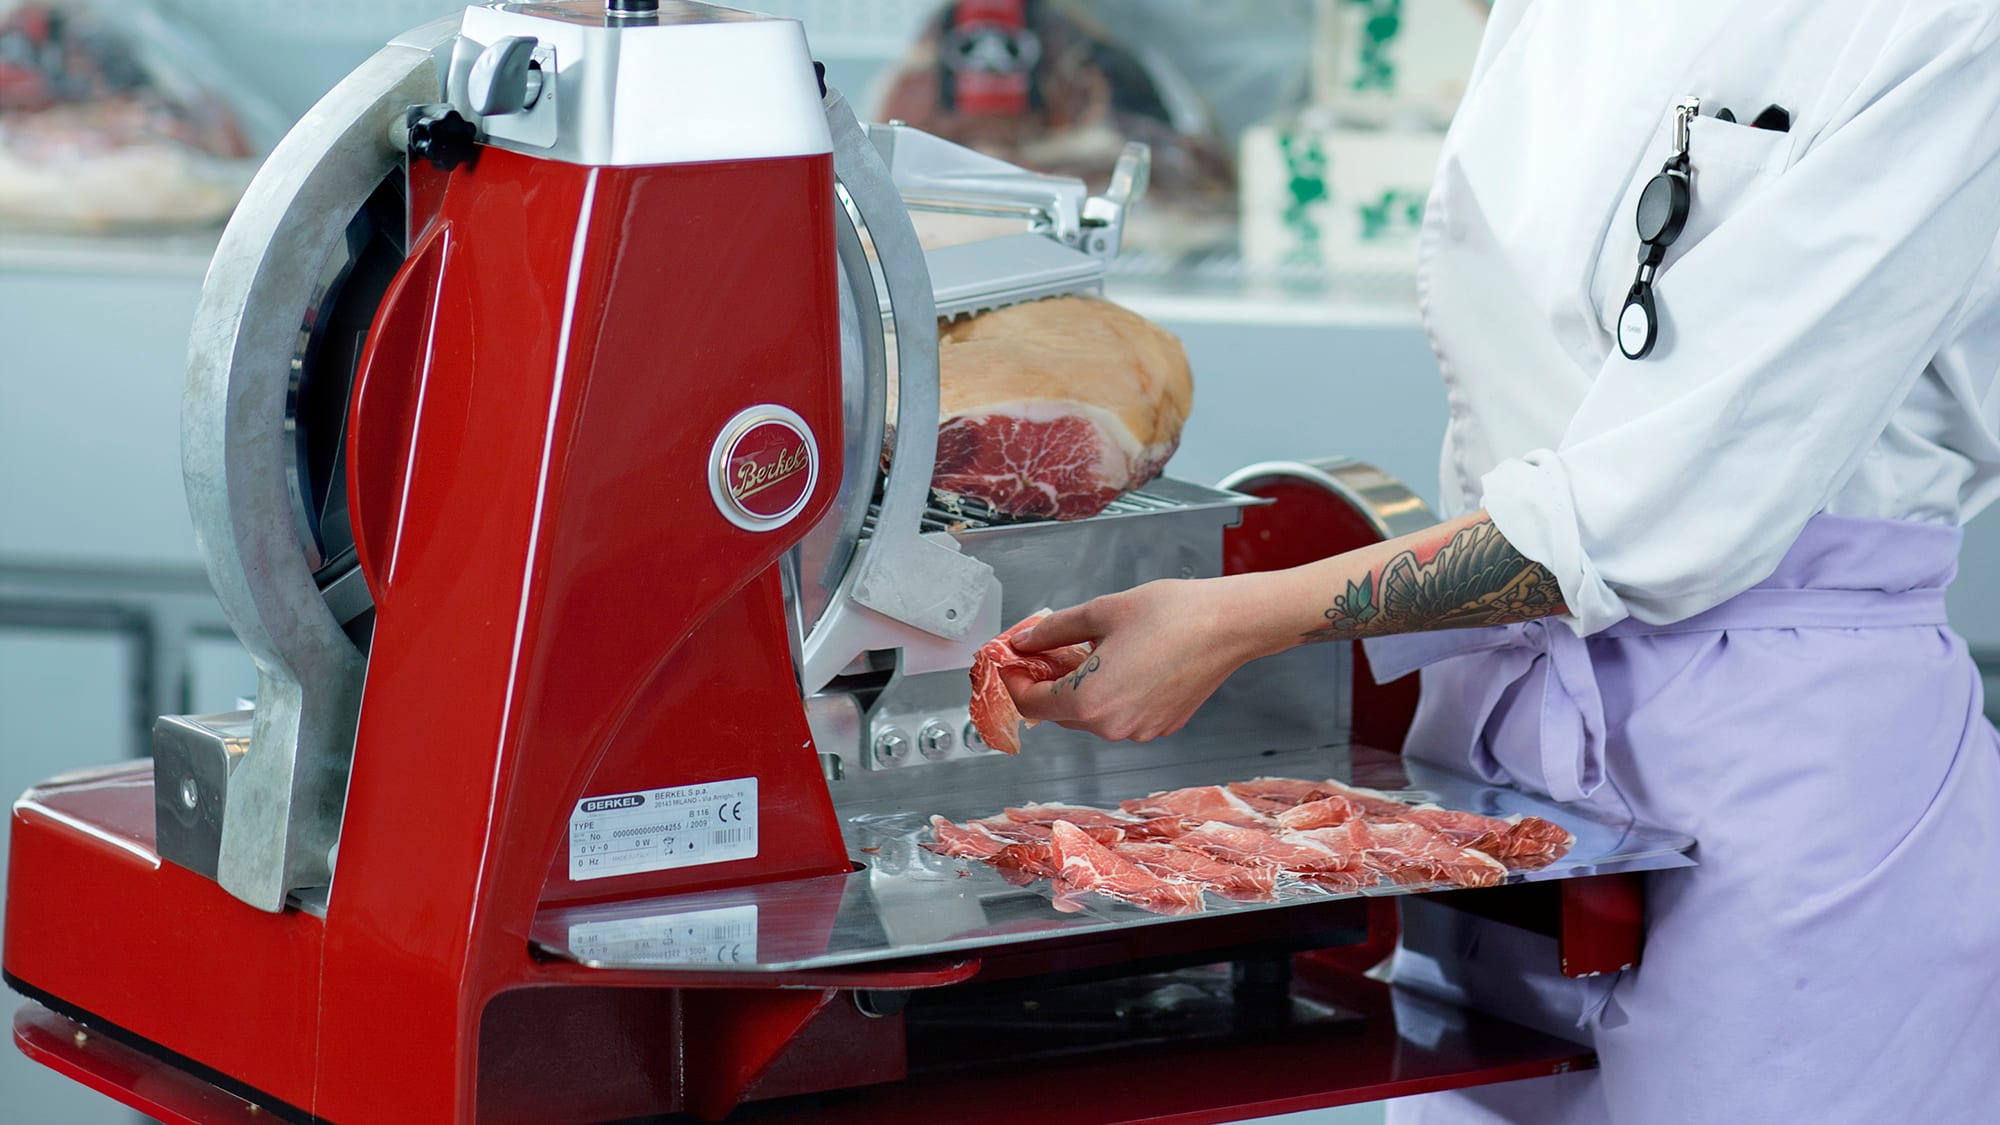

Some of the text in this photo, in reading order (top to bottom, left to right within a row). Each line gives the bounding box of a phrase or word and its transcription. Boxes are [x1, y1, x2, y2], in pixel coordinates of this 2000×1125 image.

[732, 440, 808, 497] Berkel
[655, 790, 686, 801] BERKEL
[587, 797, 639, 811] BERKEL
[689, 808, 709, 818] B 116
[574, 822, 594, 831] TYPE
[690, 820, 708, 829] 2009
[590, 845, 596, 853] V
[635, 839, 640, 847] 0
